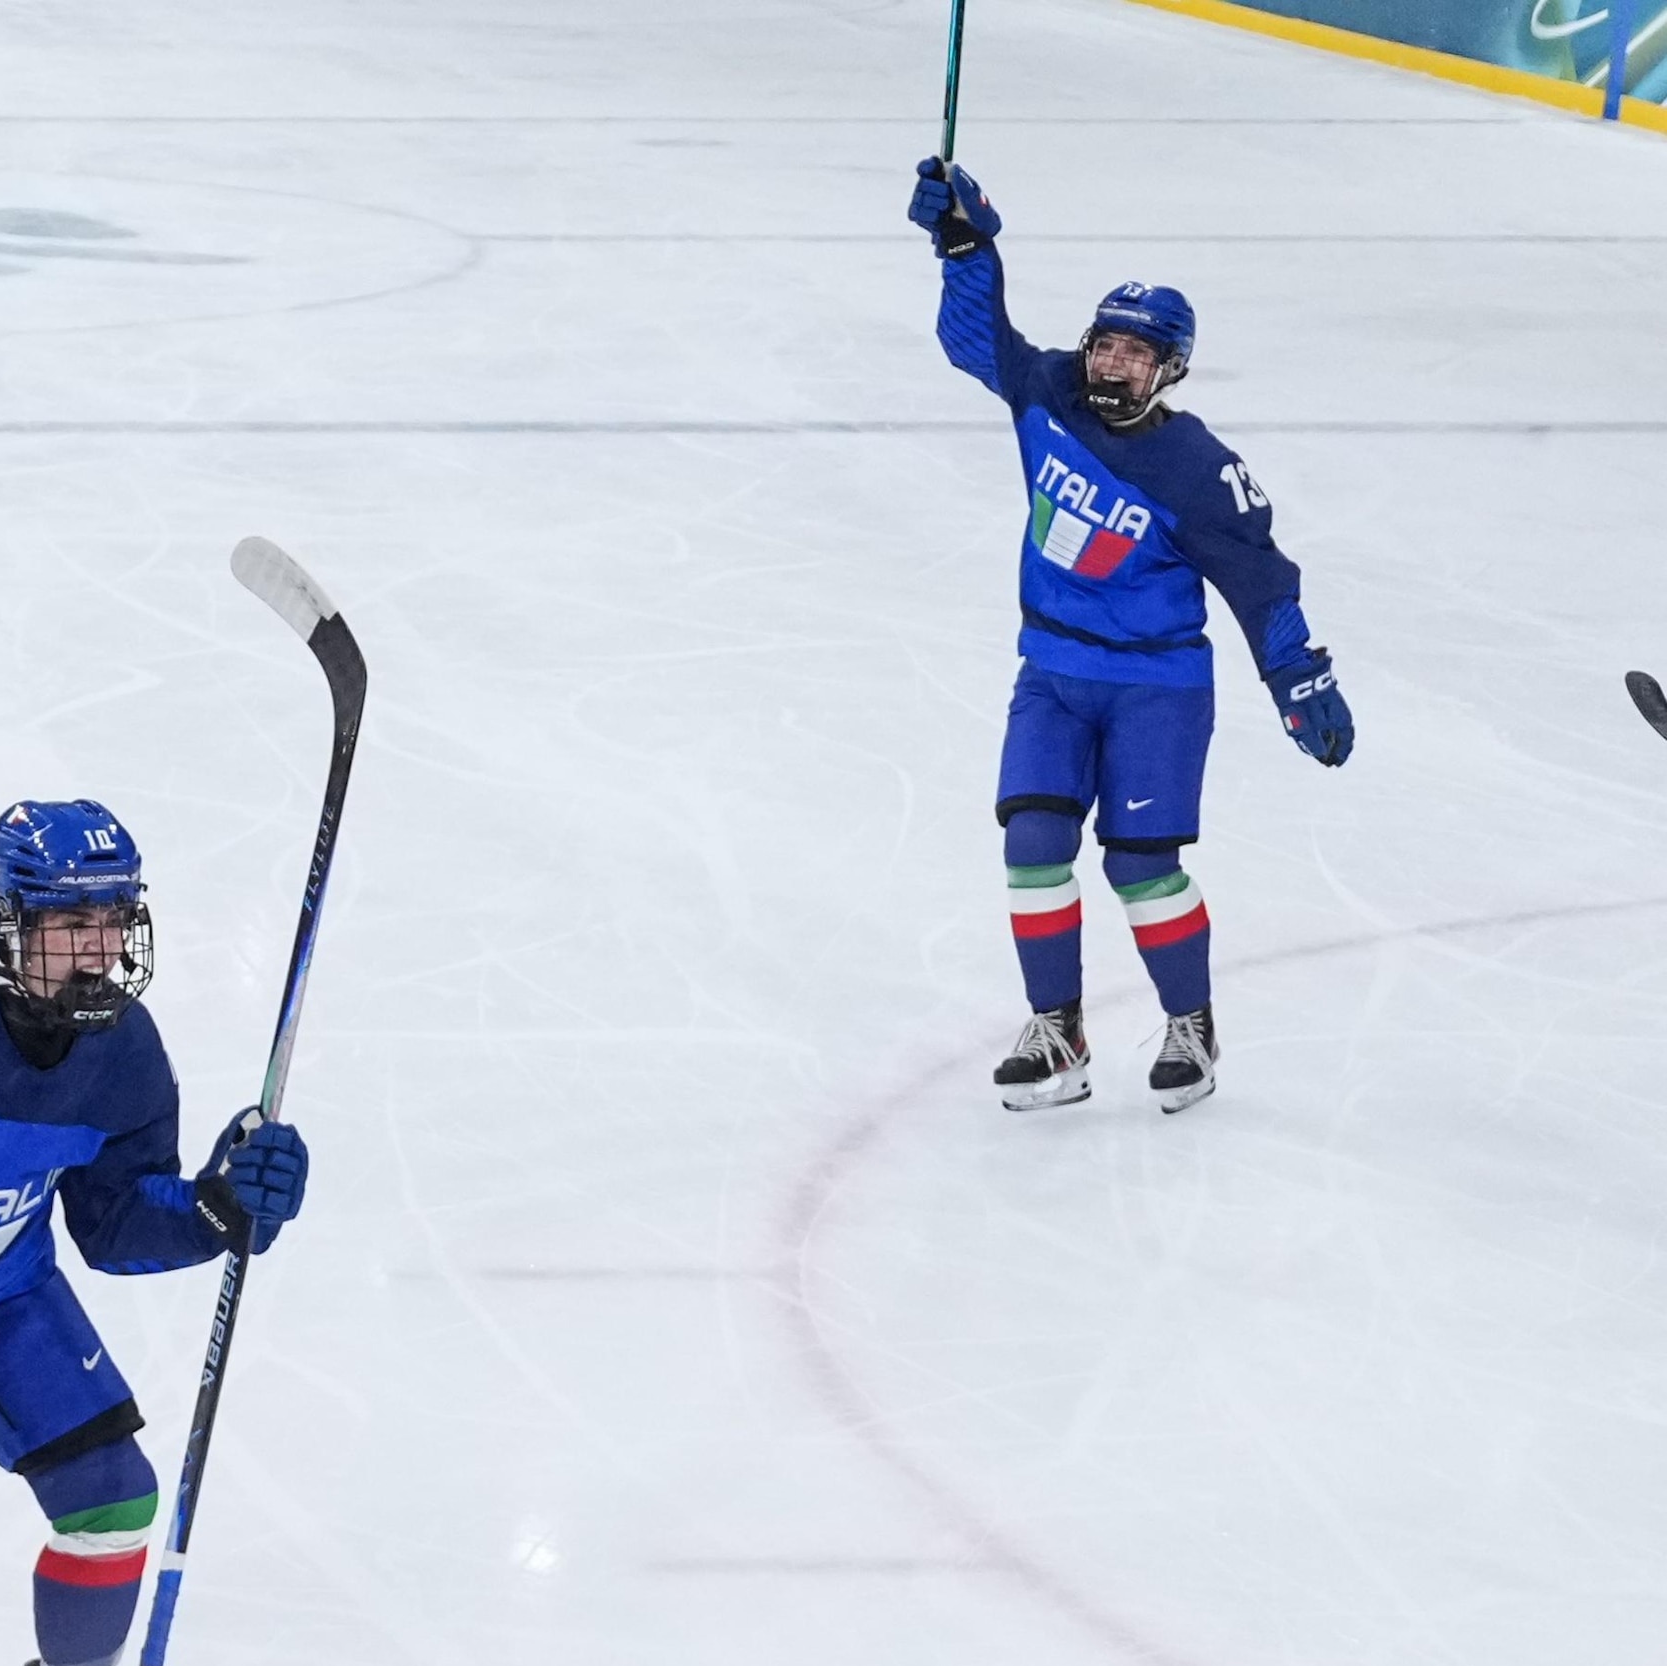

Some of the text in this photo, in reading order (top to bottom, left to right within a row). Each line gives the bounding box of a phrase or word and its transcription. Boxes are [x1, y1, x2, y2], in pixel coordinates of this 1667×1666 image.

[1036, 452, 1152, 541] ITALIA
[1219, 461, 1269, 515] 13
[1290, 671, 1338, 701] CC
[83, 828, 117, 851] 10
[196, 1199, 229, 1233] CCM
[207, 1250, 241, 1369] BAUER
